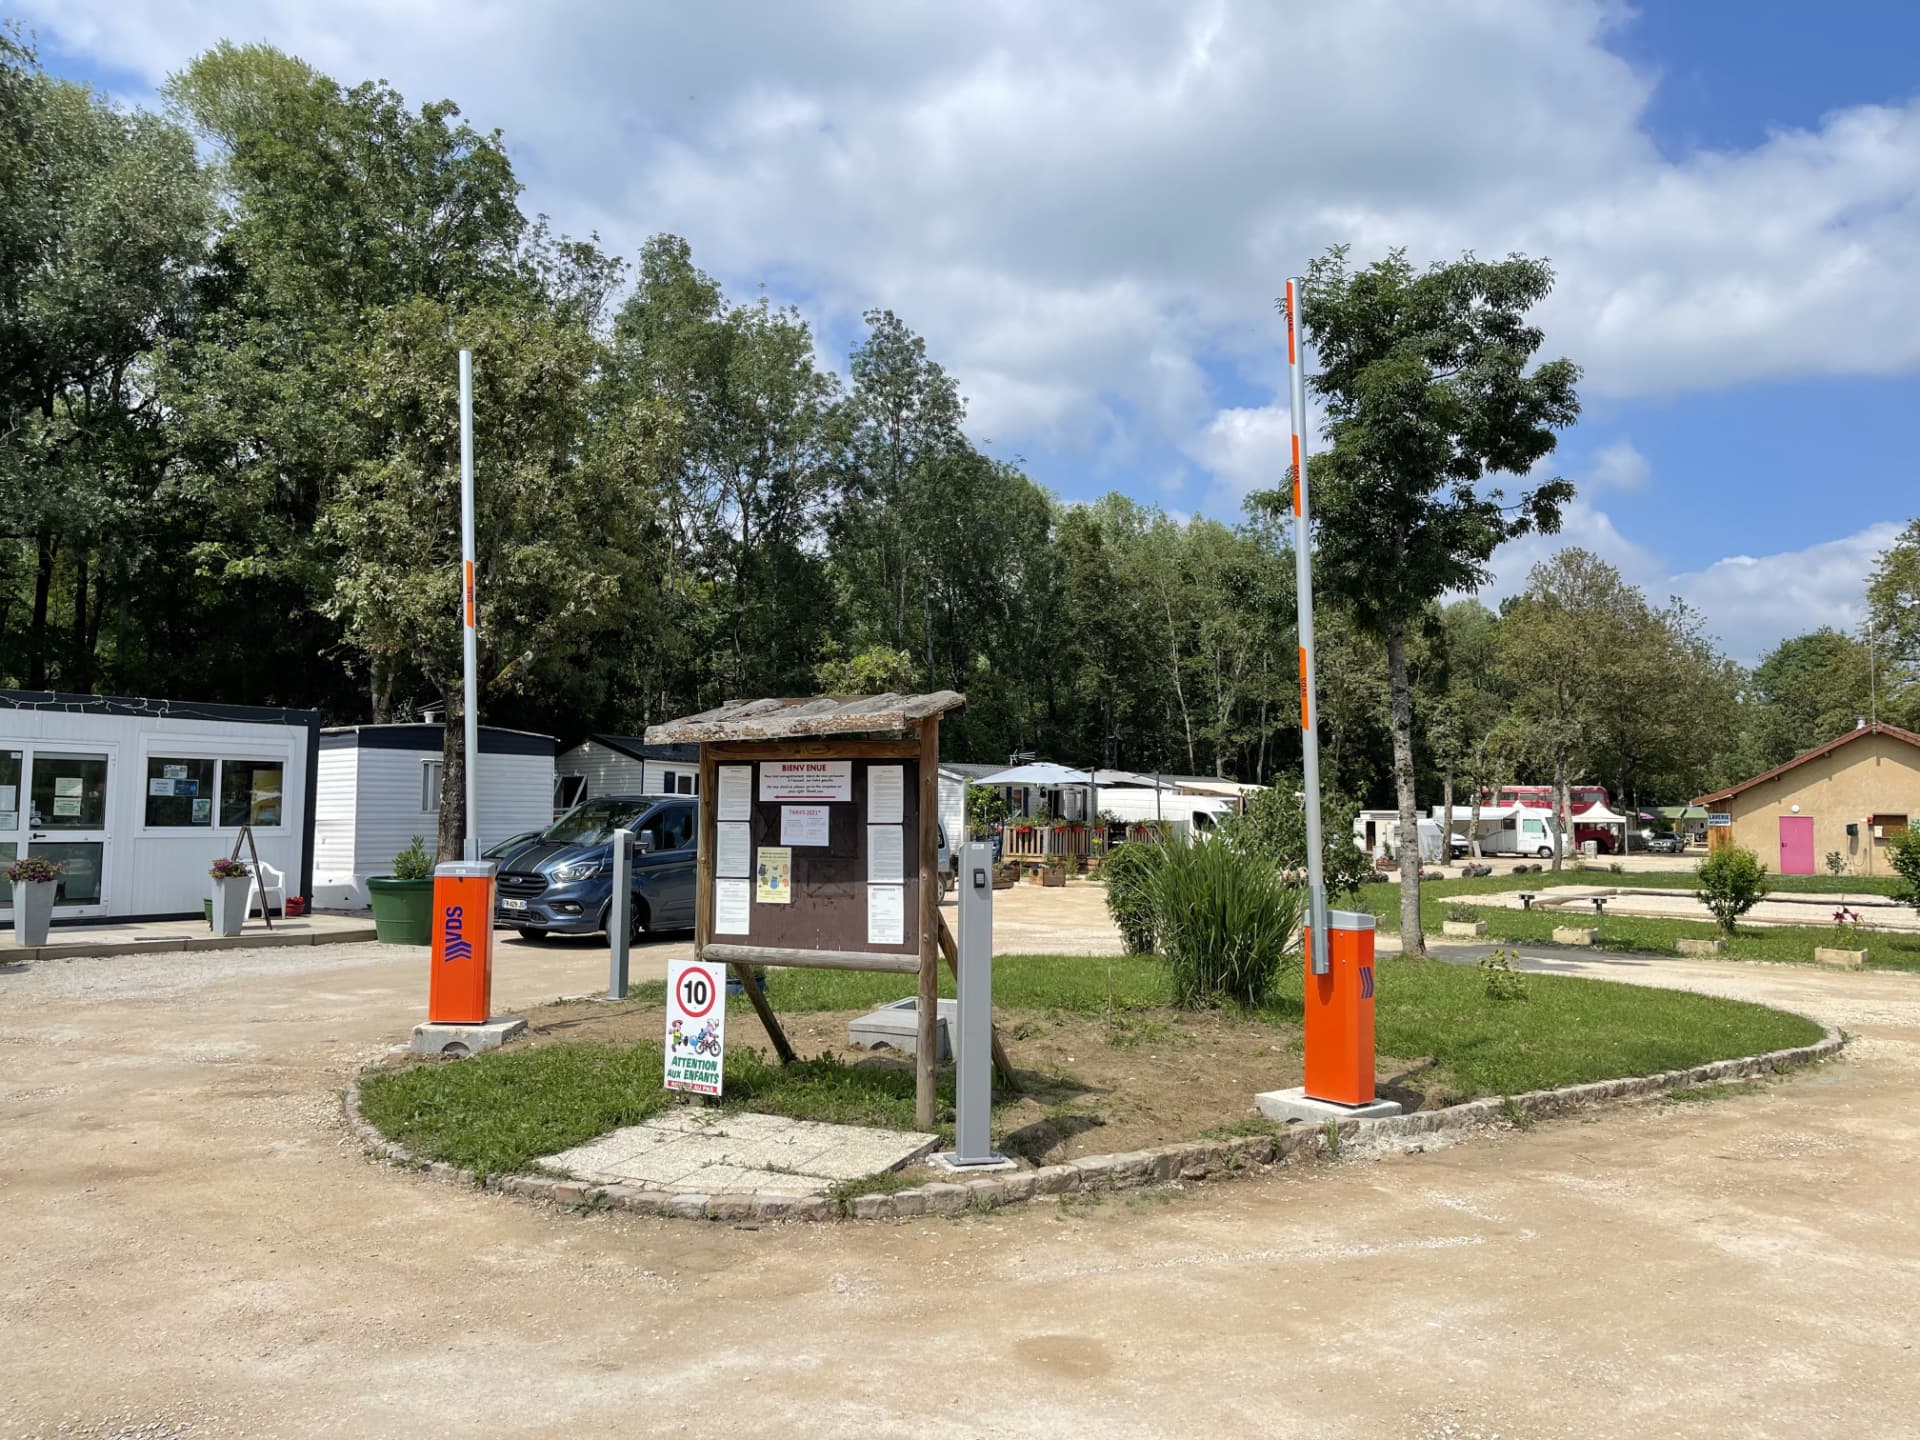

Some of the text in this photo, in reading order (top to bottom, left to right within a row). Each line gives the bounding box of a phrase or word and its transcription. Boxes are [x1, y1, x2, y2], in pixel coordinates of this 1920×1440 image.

[445, 906, 463, 943] VDS
[684, 980, 707, 1005] 10
[672, 1056, 718, 1071] ATTENTION
[667, 1069, 719, 1084] AUX ENFANTS
